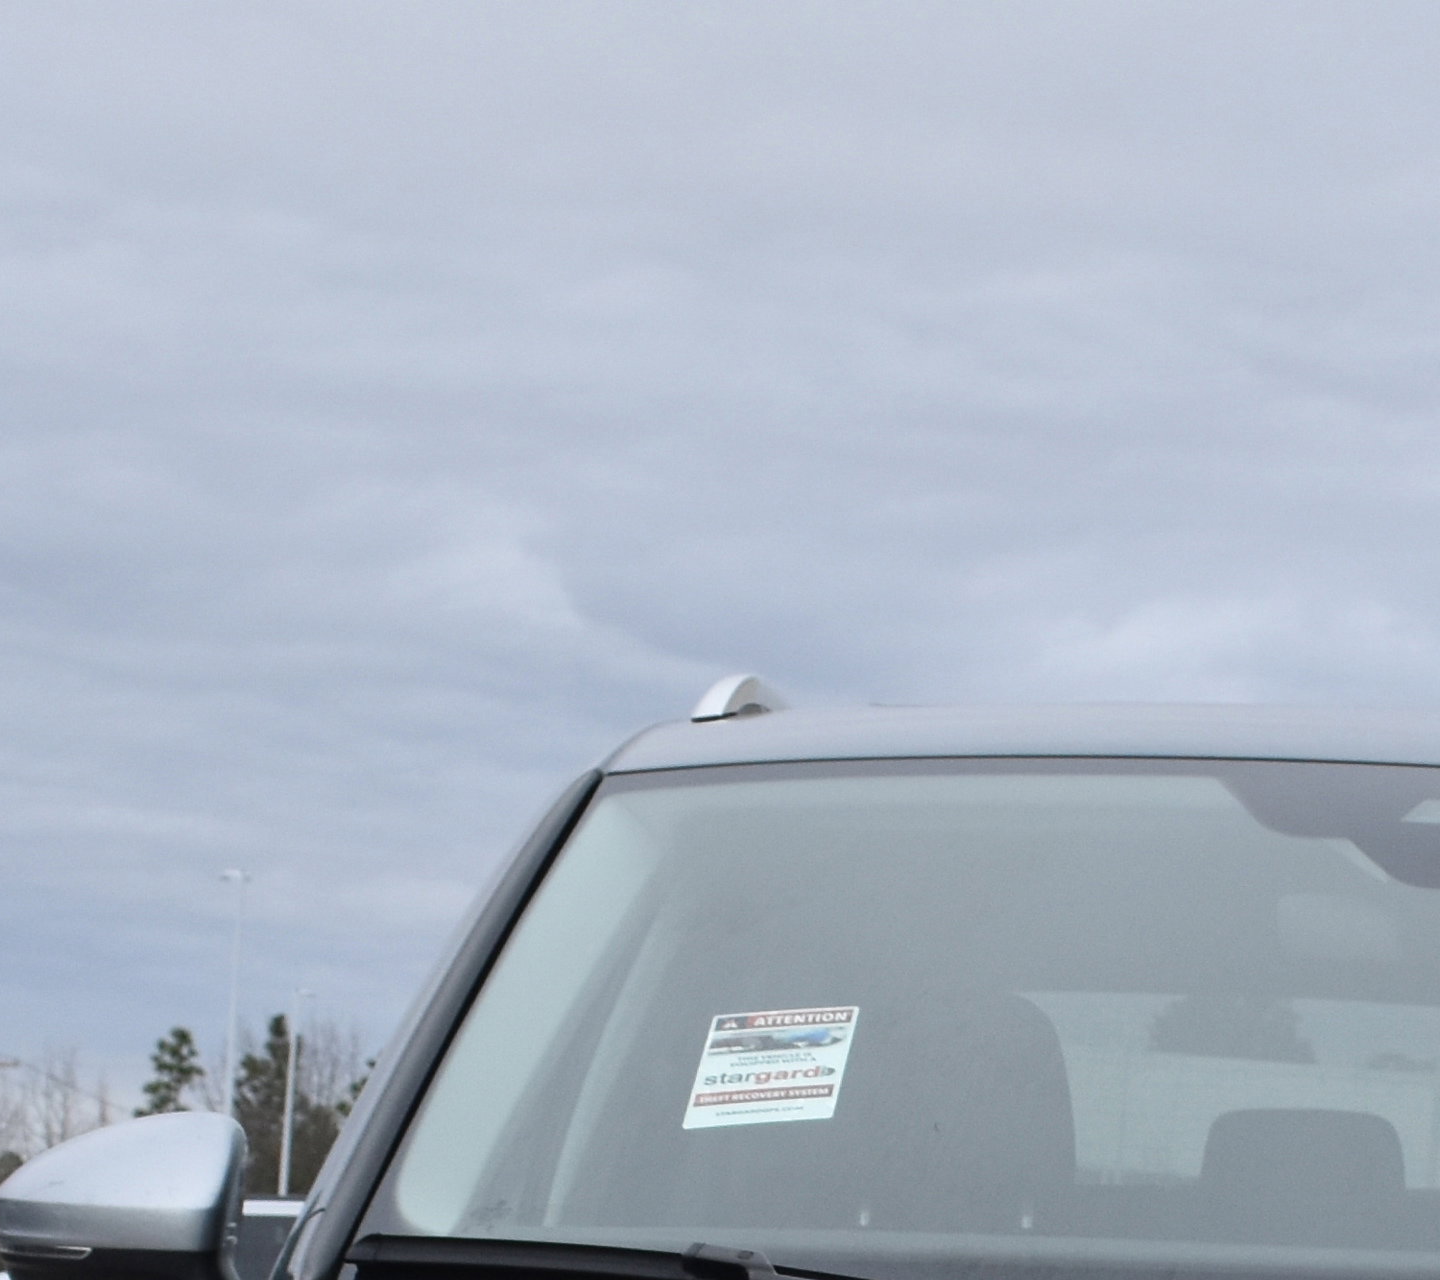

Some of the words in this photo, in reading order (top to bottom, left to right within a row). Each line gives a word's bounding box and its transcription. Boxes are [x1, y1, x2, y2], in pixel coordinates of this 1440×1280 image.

[752, 1010, 848, 1027] ATTENTION
[704, 1065, 820, 1086] stargard
[700, 1093, 730, 1104] THEFT
[732, 1090, 786, 1101] RECOVERY
[788, 1087, 829, 1098] SYSTEM
